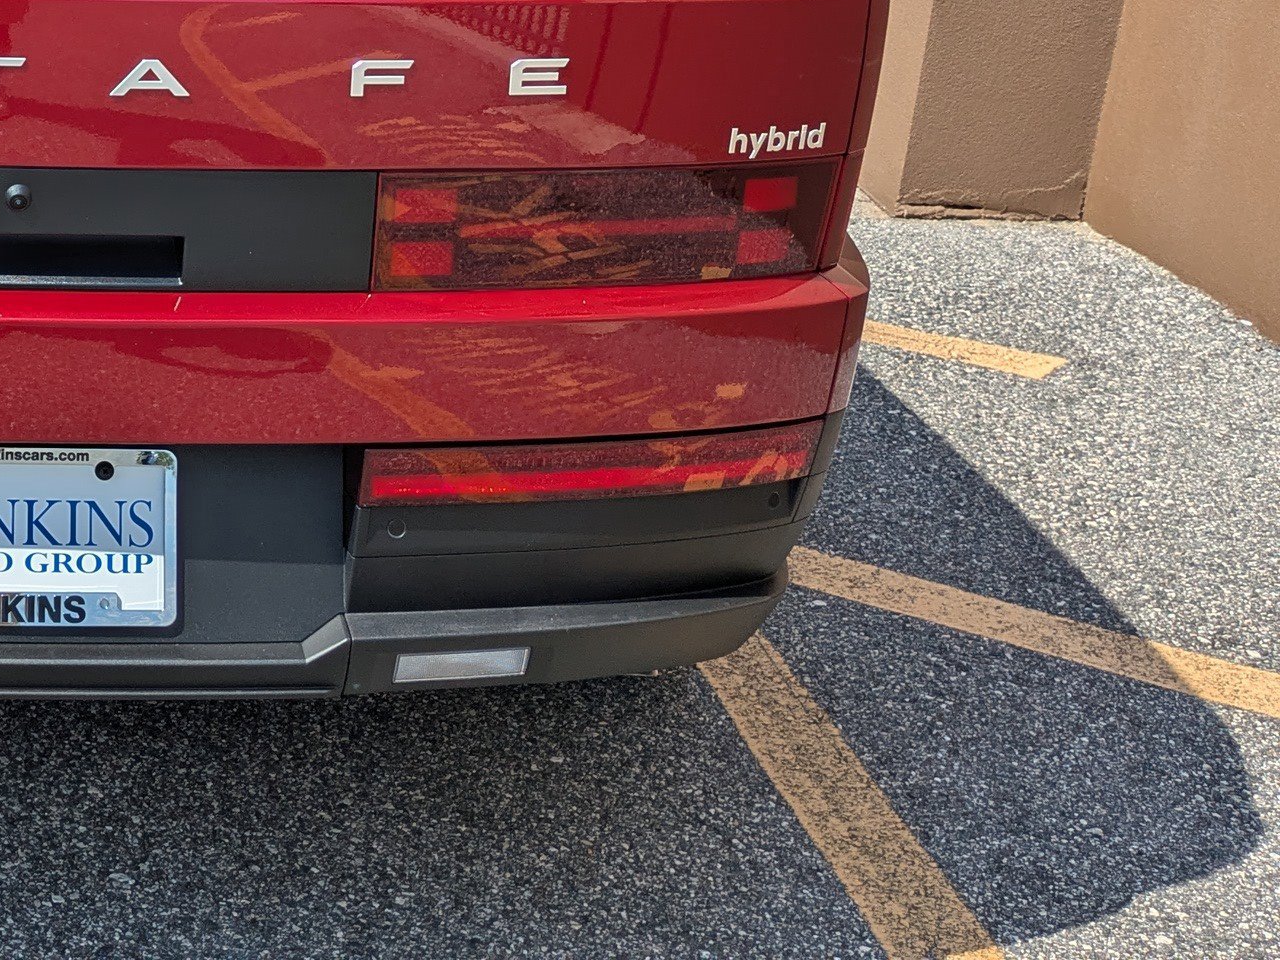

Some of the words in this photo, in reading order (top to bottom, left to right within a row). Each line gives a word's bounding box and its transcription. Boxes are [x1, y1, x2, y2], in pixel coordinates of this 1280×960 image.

[350, 58, 570, 97] FE
[728, 122, 827, 160] hybrid
[24, 552, 154, 575] GROUP
